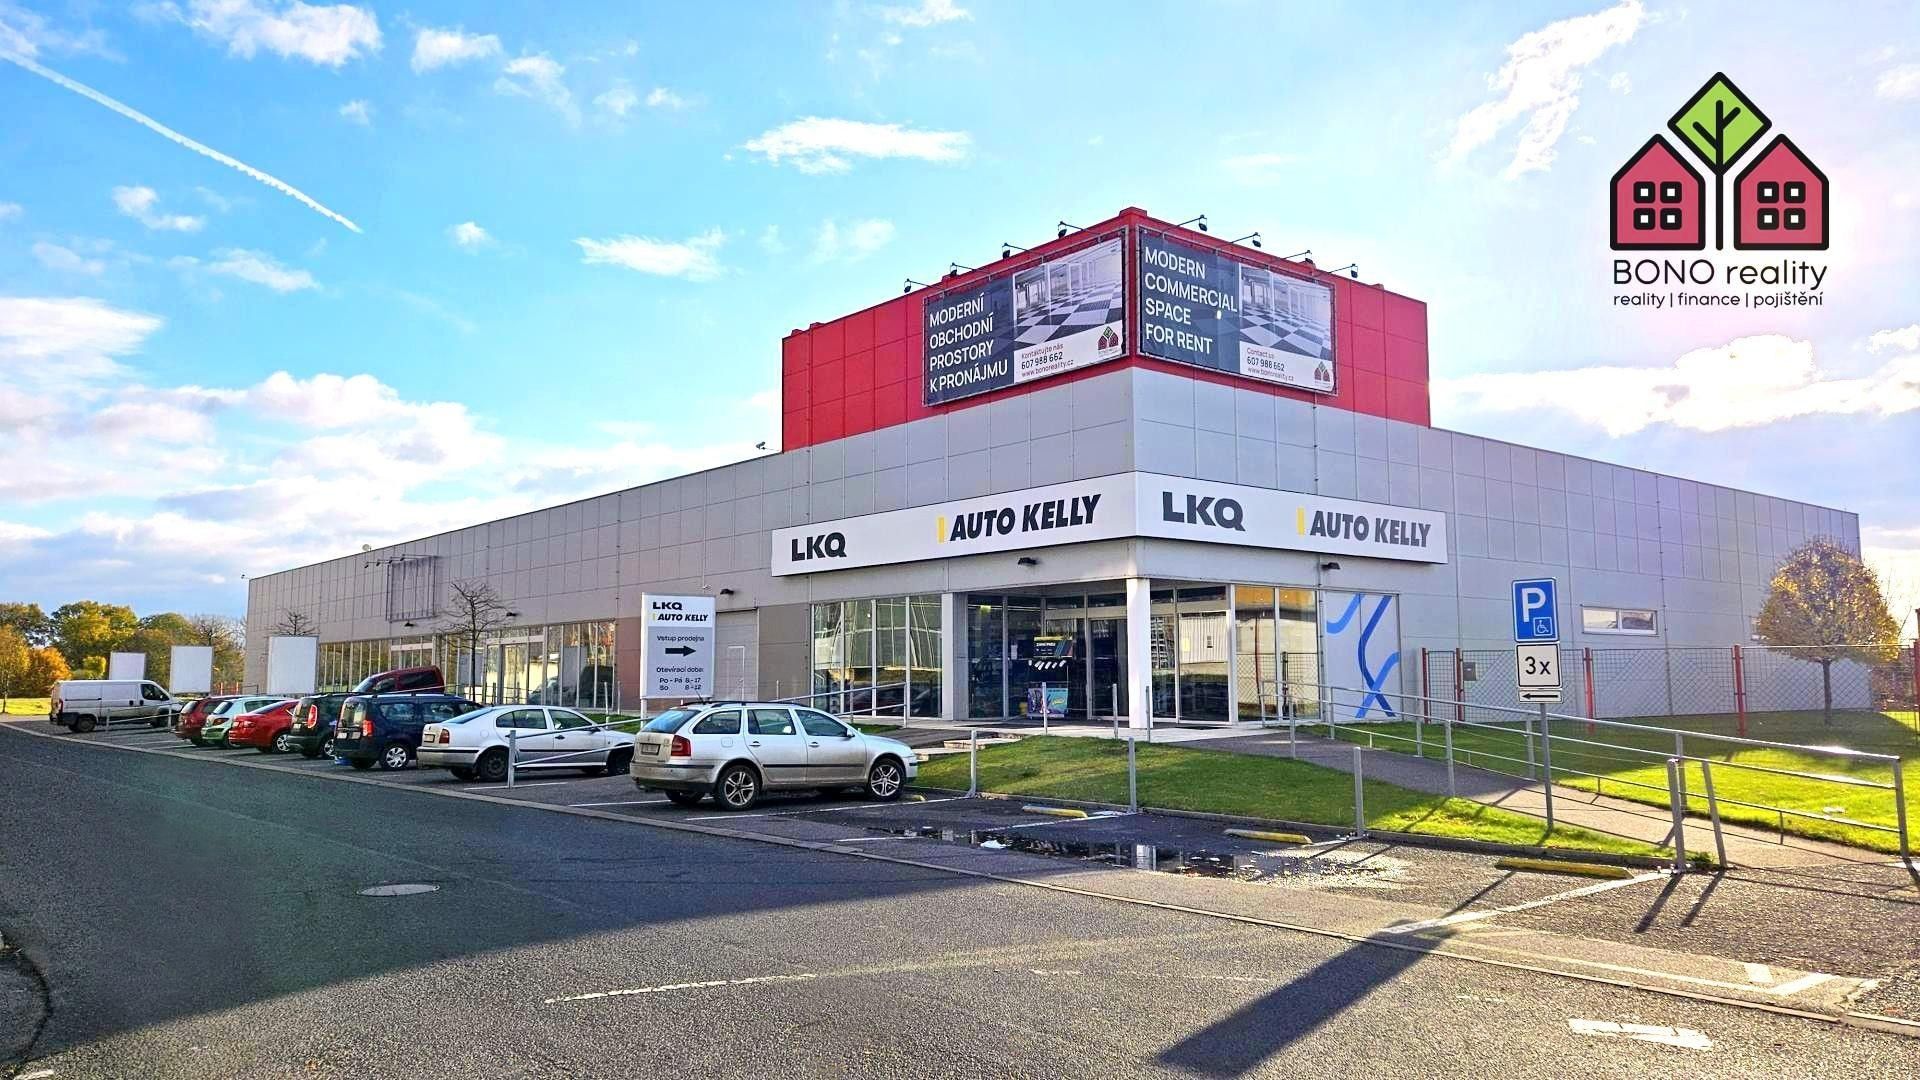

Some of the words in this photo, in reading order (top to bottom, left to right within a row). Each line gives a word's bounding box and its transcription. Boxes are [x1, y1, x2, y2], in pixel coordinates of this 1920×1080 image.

[1145, 246, 1205, 280] MODERN
[1145, 272, 1238, 313] COMMERCIAL
[929, 292, 985, 328] MODERNÍ
[1145, 298, 1192, 325] SPACE
[929, 312, 994, 349] OBCHODNÍ
[1145, 322, 1174, 346] FOR
[1176, 331, 1213, 355] RENT
[929, 339, 994, 372] PROSTORY
[1021, 345, 1052, 359] Kontaktujte
[1021, 359, 1034, 370] 607
[1049, 351, 1063, 362] 662
[1247, 356, 1259, 366] 607
[1260, 358, 1272, 369] 988
[930, 377, 938, 393] K
[939, 359, 1008, 391] PRONÁJMU
[949, 507, 1015, 542] AUTO
[1021, 494, 1102, 533] KELLY
[1162, 491, 1246, 532] LKQ
[1310, 510, 1370, 542] AUTO
[1374, 517, 1432, 548] KELLY
[791, 532, 847, 562] LKQ
[652, 601, 683, 611] LKQ
[657, 613, 683, 621] AUTO
[684, 614, 709, 622] KELLY
[1521, 587, 1546, 623] P
[1524, 656, 1552, 675] 3x
